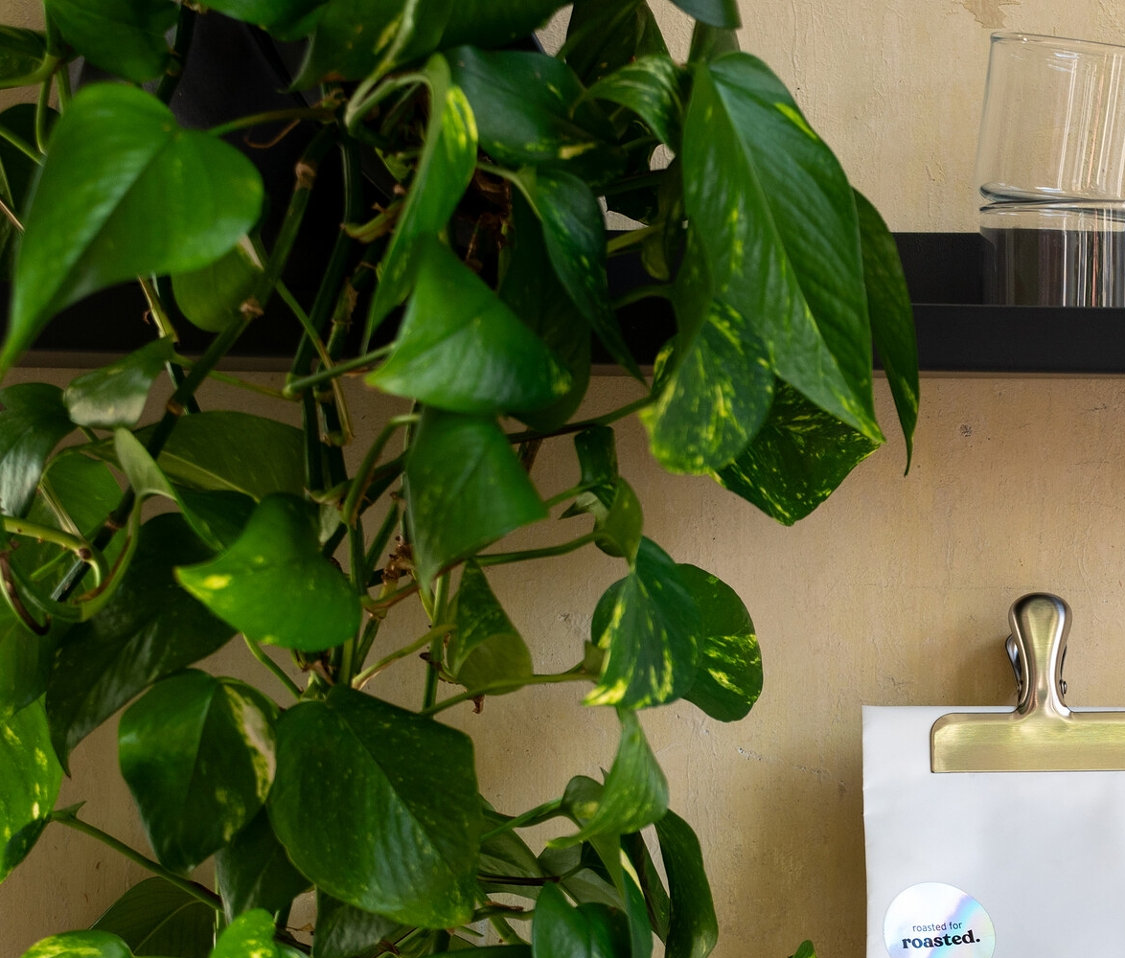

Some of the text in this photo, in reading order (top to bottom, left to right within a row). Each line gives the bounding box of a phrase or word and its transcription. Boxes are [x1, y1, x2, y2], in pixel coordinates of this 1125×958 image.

[912, 921, 962, 932] roasted for
[902, 929, 980, 949] roasted.
